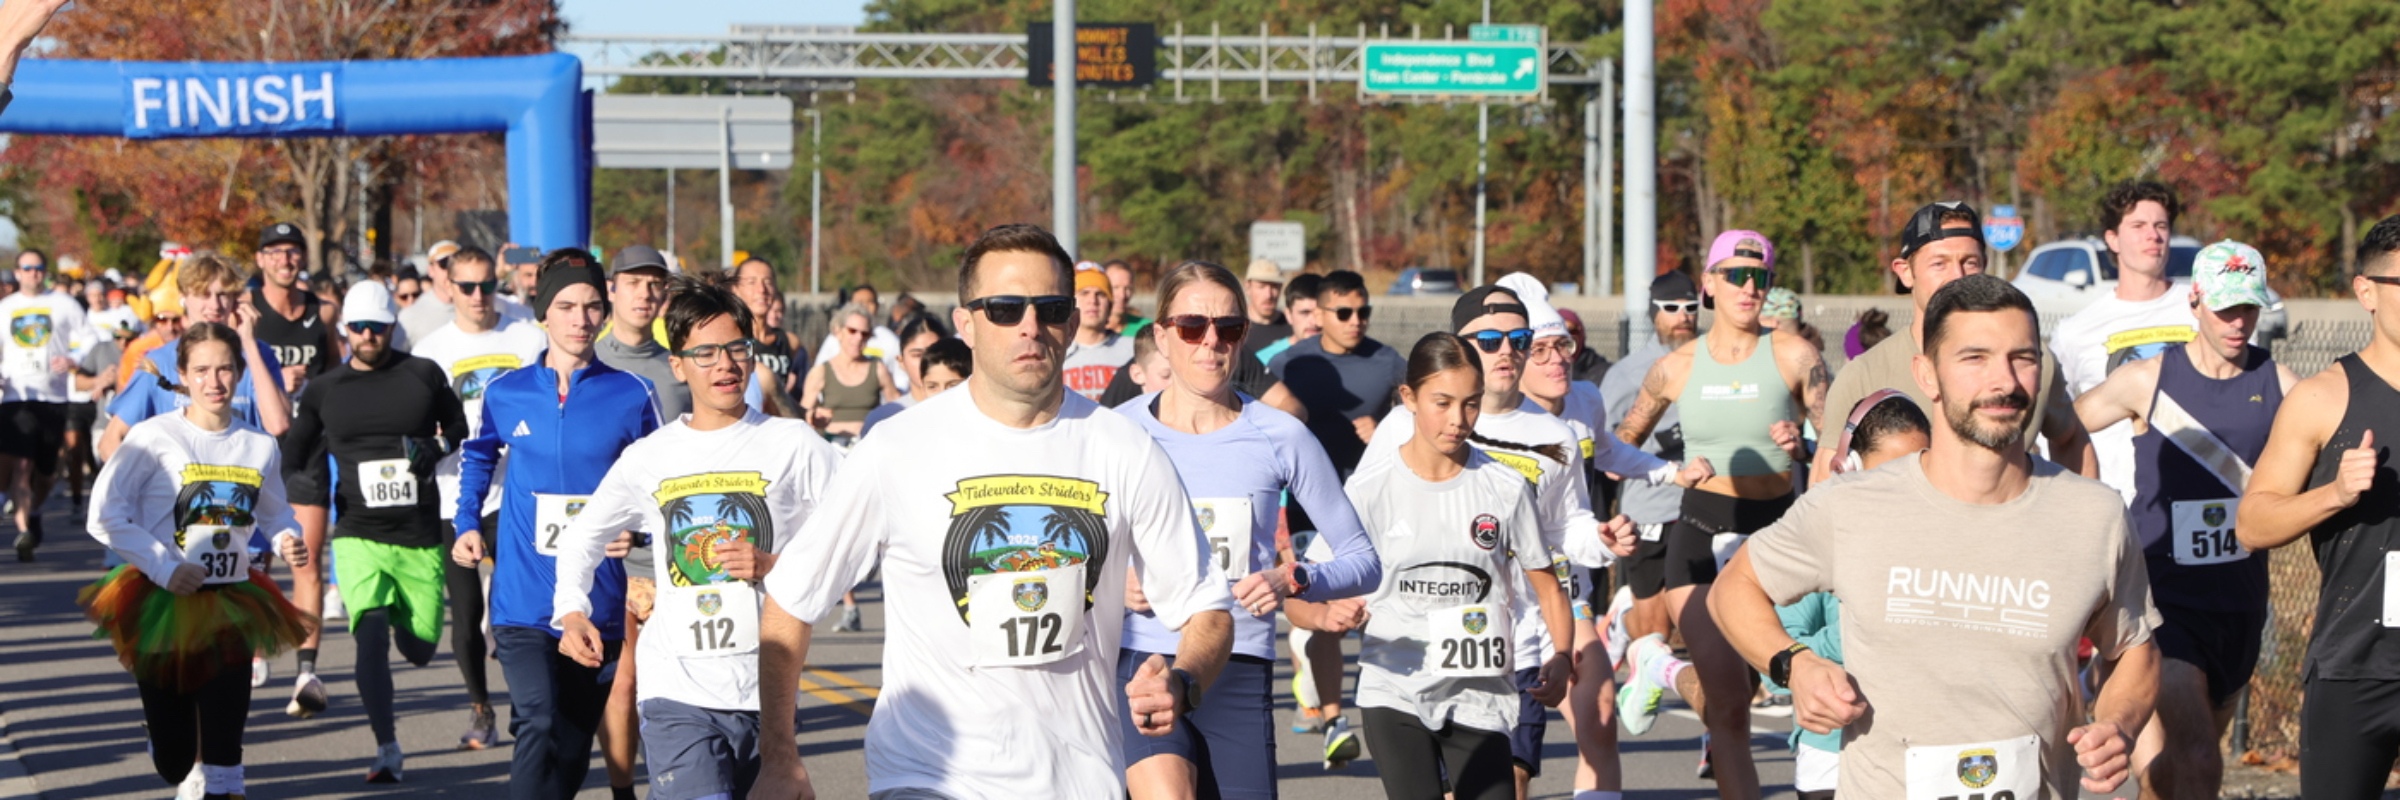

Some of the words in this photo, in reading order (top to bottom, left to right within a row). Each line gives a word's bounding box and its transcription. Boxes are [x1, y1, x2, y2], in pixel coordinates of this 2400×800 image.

[1380, 53, 1462, 69] Independence
[1466, 53, 1496, 68] Blvd
[1369, 70, 1400, 84] Town
[1402, 70, 1440, 84] Center
[1451, 70, 1508, 85] Pembroke
[133, 72, 336, 129] FINISH
[367, 481, 412, 502] 1864
[713, 477, 755, 489] Striders
[964, 483, 1036, 501] Tidewater
[1038, 482, 1092, 502] Striders
[1007, 535, 1038, 545] 2025
[2192, 528, 2239, 559] 514
[200, 552, 239, 578] 337
[1399, 580, 1484, 597] INTEGRITY
[1887, 566, 2051, 610] RUNNING
[1886, 597, 2050, 628] ETC
[689, 617, 736, 651] 112
[1000, 612, 1062, 657] 172
[1441, 636, 1506, 670] 2013
